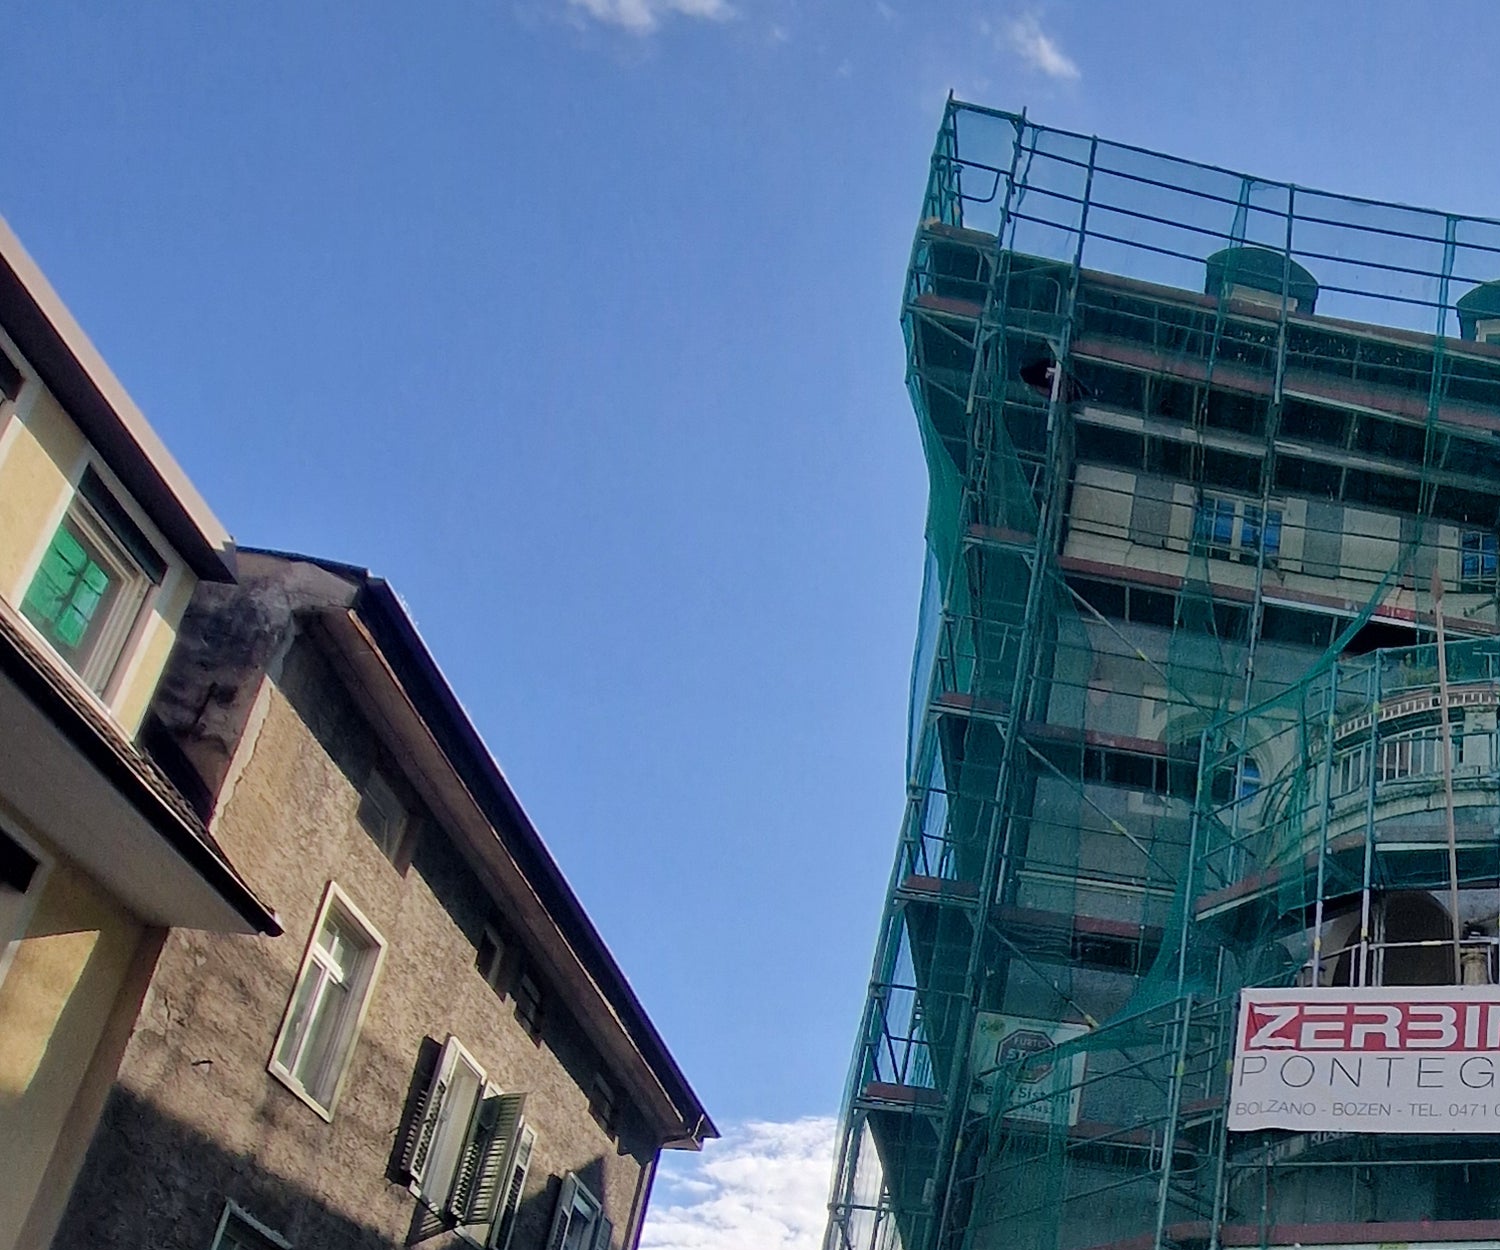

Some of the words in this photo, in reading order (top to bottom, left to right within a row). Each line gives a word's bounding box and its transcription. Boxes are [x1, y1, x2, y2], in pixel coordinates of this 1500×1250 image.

[1235, 1099, 1317, 1117] BOLZANO
[1331, 1102, 1392, 1117] BOZEN
[1408, 1102, 1443, 1117] TEL.
[1448, 1102, 1488, 1117] 0471
